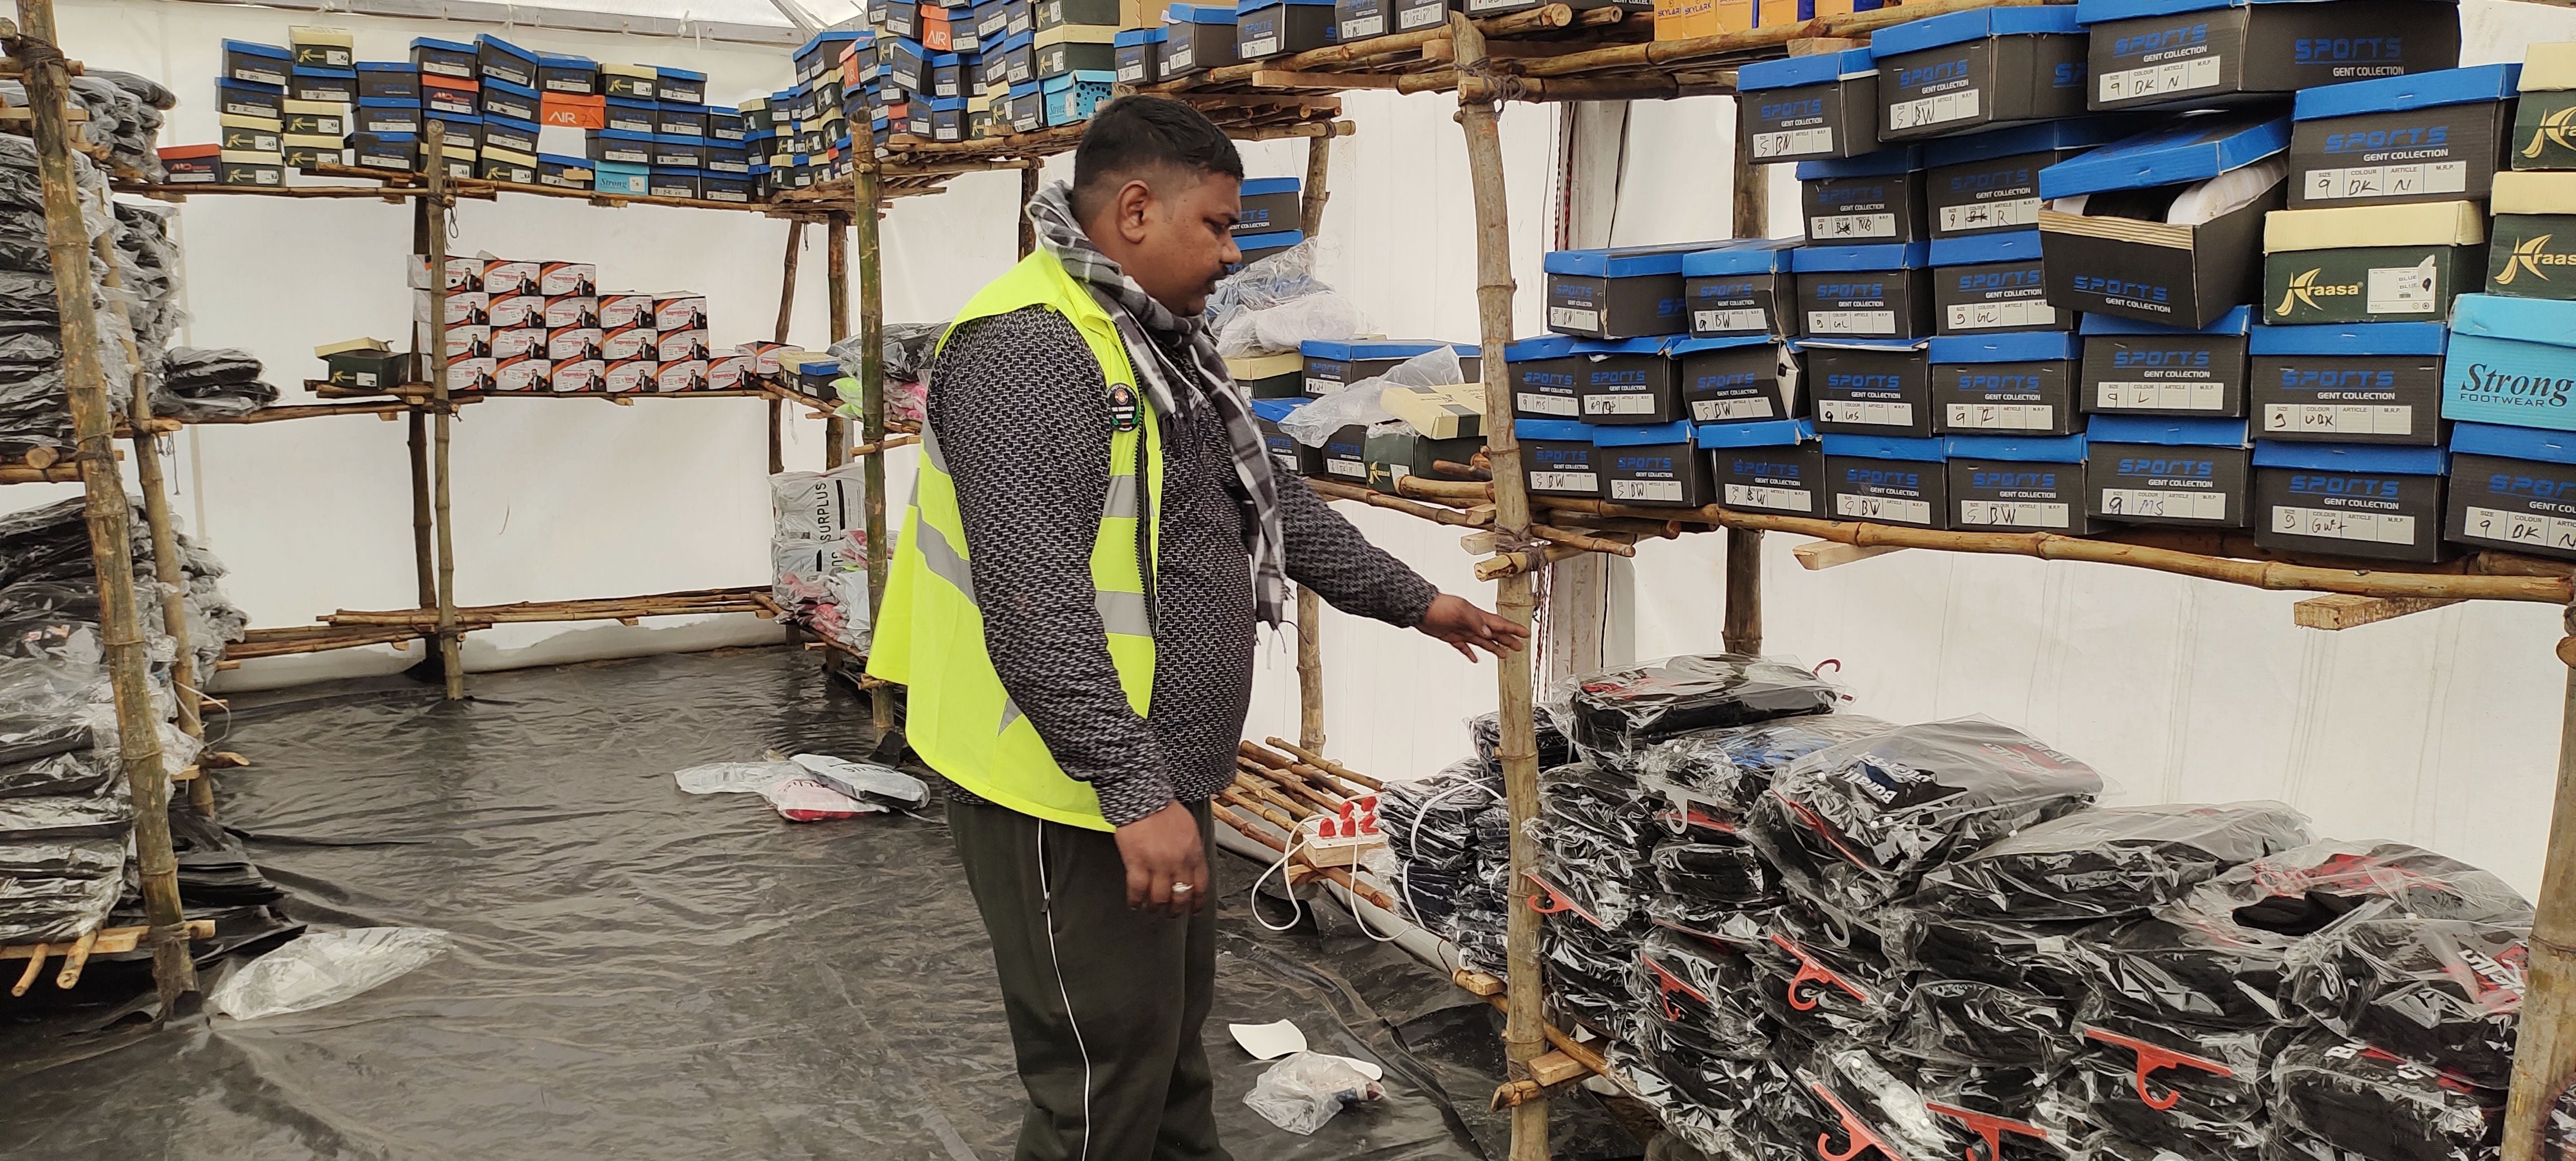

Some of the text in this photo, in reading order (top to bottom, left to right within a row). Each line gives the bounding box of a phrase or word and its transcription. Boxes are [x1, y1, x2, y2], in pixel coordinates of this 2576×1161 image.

[1684, 3, 1712, 15] SKYLARK
[927, 30, 946, 46] AIR
[2114, 23, 2208, 54] SPORTS
[2143, 45, 2207, 62] GENT COLLECTION
[2295, 37, 2402, 60] SPORTS
[1900, 59, 1968, 86] SPORTS
[2333, 65, 2404, 77] GENT COLLECTION
[1922, 79, 1968, 94] GENT COLLECTION
[1761, 98, 1822, 118] SPORTS
[548, 111, 576, 124] AIR
[1781, 117, 1822, 128] GENT COLLECTION
[2324, 126, 2448, 150] SPORTS
[2363, 148, 2449, 162] GENT COLLECTION
[600, 178, 627, 188] Strong
[1952, 169, 2029, 190] SPORTS
[1819, 187, 1883, 201] SPORTS
[1993, 187, 2030, 197] COLLECTION
[1959, 270, 2040, 289] SPORTS
[1555, 285, 1592, 296] SPORTS
[1817, 284, 1883, 297] SPORTS
[2004, 289, 2042, 297] COLLECTION
[2074, 275, 2168, 301] SPORTS
[2275, 267, 2359, 316] Kraasa
[2105, 298, 2171, 314] GENT COLLECTION
[2114, 351, 2210, 366] SPORTS
[1697, 373, 1754, 389] SPORTS
[1828, 375, 1900, 388] SPORTS
[1959, 376, 2039, 389] SPORTS
[2281, 371, 2395, 386] SPORTS
[2460, 363, 2574, 407] Strong
[2460, 393, 2544, 407] FOOTWEAR
[1734, 460, 1798, 475] SPORTS
[2118, 459, 2213, 475] SPORTS
[1846, 469, 1919, 485] SPORTS
[1973, 473, 2056, 487] SPORTS
[1886, 488, 1919, 497] COLLECTION
[2289, 476, 2400, 495] SPORTS
[2348, 499, 2399, 509] COLLECTION
[2530, 501, 2556, 511] GENT
[816, 483, 831, 541] SURPLUS
